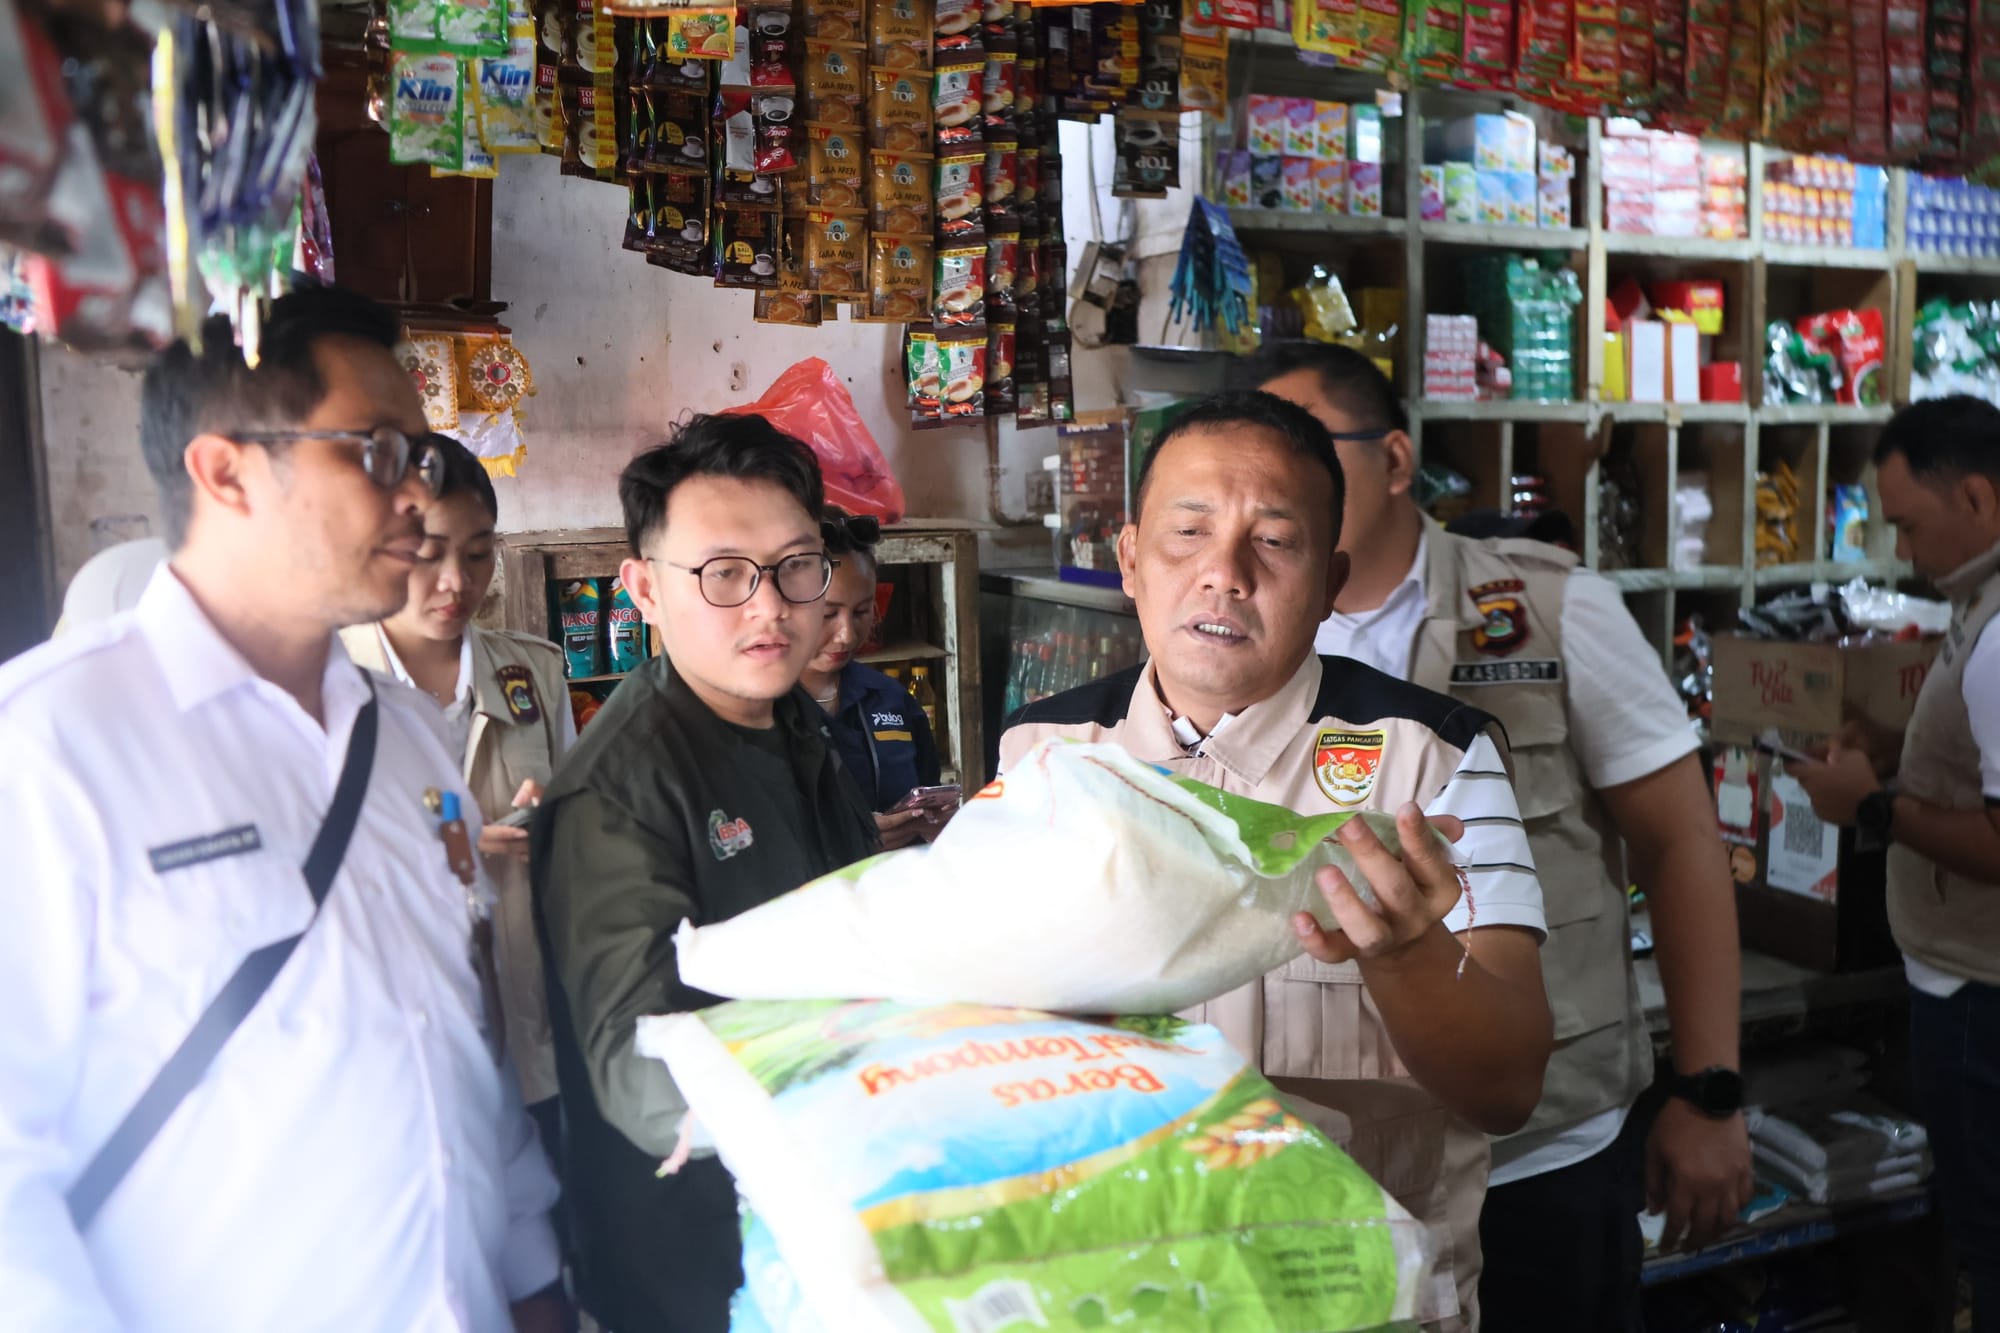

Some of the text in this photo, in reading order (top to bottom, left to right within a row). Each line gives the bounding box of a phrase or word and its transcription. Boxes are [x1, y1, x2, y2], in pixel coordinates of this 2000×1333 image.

[892, 7, 916, 19] TOP
[480, 59, 532, 86] Klin
[823, 63, 849, 75] TOP
[397, 78, 453, 102] Klin
[891, 90, 916, 102] TOP
[823, 147, 849, 158] TOP
[1135, 155, 1172, 170] TOP
[891, 173, 916, 185] TOP
[823, 231, 850, 242] TOP
[891, 257, 916, 269] TOP
[609, 607, 641, 623] NGO
[1322, 735, 1346, 744] SATGAS
[717, 817, 750, 842] BSA
[858, 1035, 1104, 1097] Tempong
[991, 1063, 1167, 1109] Beras
